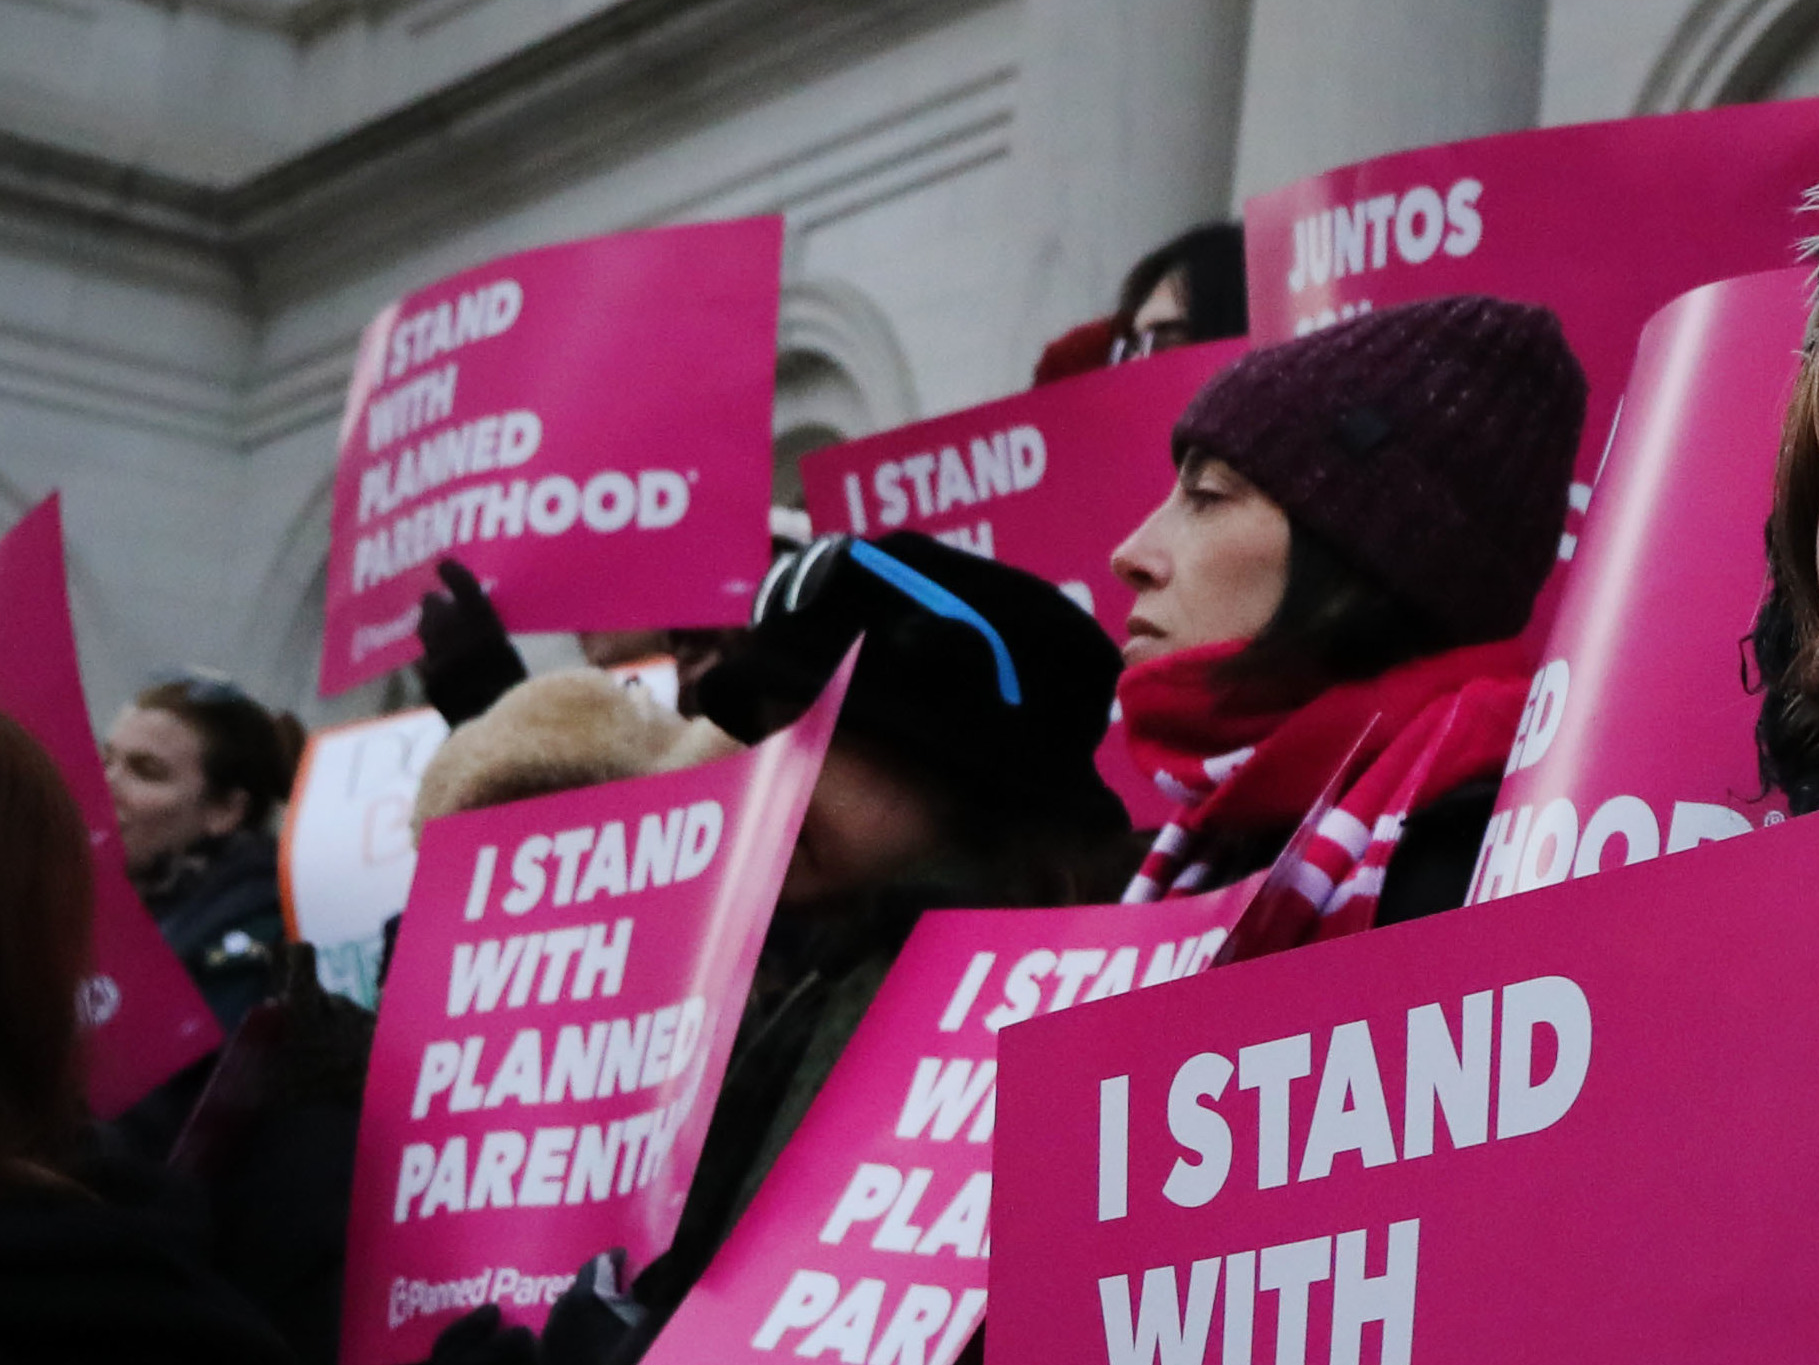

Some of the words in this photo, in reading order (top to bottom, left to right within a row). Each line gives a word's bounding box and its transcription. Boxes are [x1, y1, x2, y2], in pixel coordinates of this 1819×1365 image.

[1288, 178, 1483, 293] JUNTOS
[390, 279, 524, 377] STAND
[368, 363, 459, 451] WITH
[358, 410, 543, 523] PLANNED
[845, 473, 867, 534] I
[874, 425, 1047, 526] STAND
[464, 846, 498, 922] I
[502, 800, 724, 916] STAND
[446, 918, 634, 1019] WITH
[939, 952, 997, 1032] I
[410, 996, 704, 1120] PLANNED
[1098, 1074, 1128, 1222] I
[1163, 974, 1593, 1208] STAND
